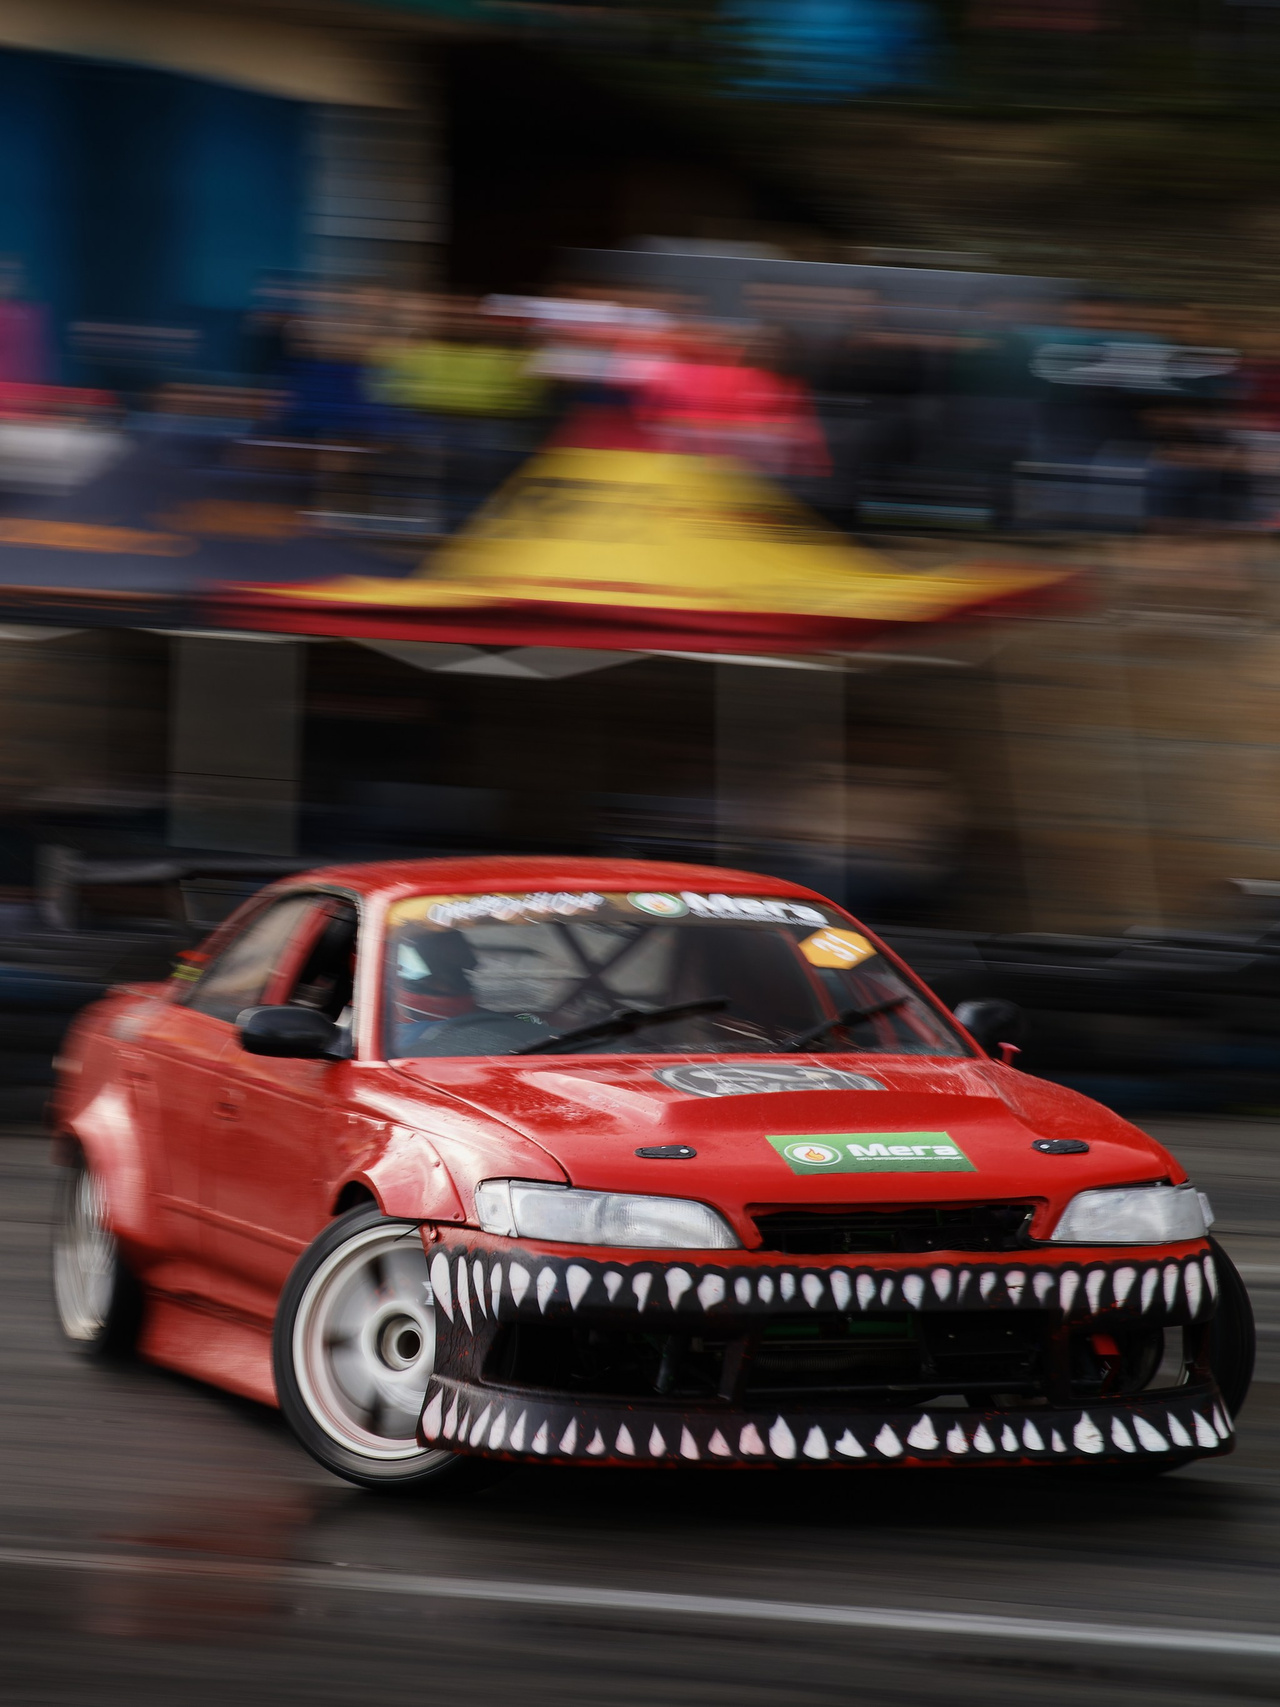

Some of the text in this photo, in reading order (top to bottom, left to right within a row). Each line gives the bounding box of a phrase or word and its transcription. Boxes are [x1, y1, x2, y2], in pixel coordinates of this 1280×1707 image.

[680, 891, 829, 924] Мега
[811, 931, 867, 962] 31
[846, 1143, 960, 1157] Мега
